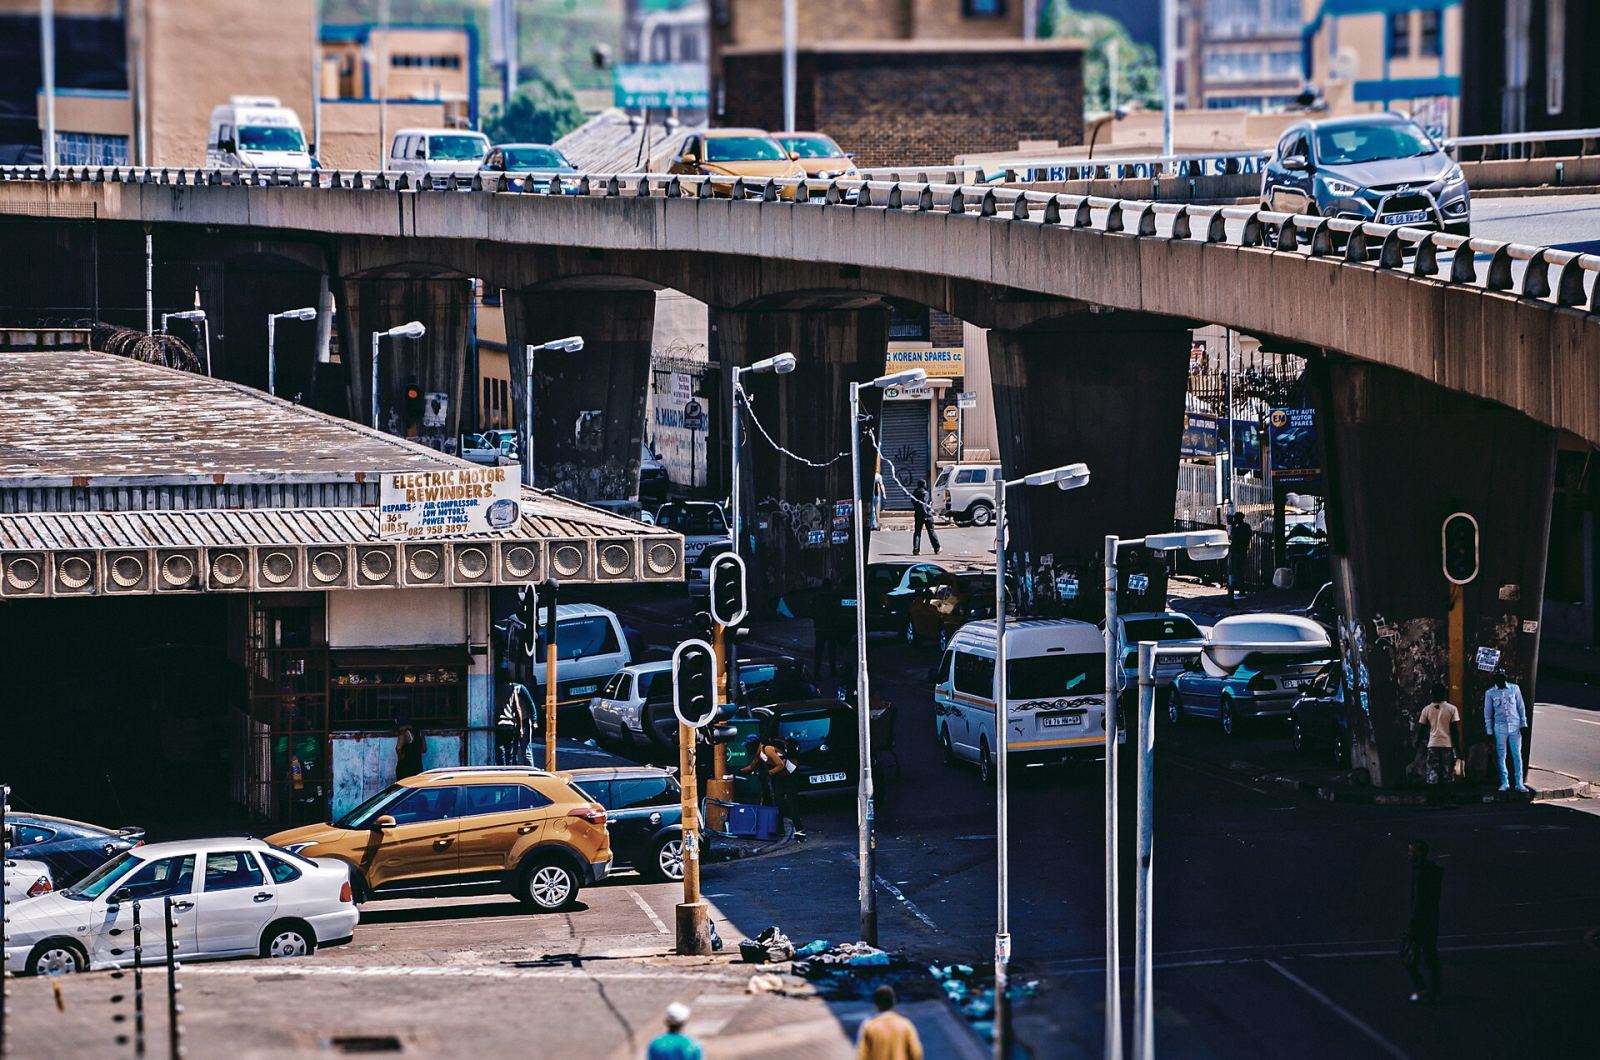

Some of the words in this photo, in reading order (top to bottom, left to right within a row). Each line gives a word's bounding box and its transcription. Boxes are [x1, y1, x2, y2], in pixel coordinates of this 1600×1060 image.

[893, 352, 922, 361] KOREAN
[925, 351, 951, 361] SPARES
[886, 389, 898, 397] KS
[392, 471, 454, 489] ELECTRIC
[459, 468, 505, 484] MOTOR
[422, 516, 445, 525] POWER
[409, 527, 423, 536] 082
[427, 526, 442, 534] 958
[445, 524, 468, 533] 3897
